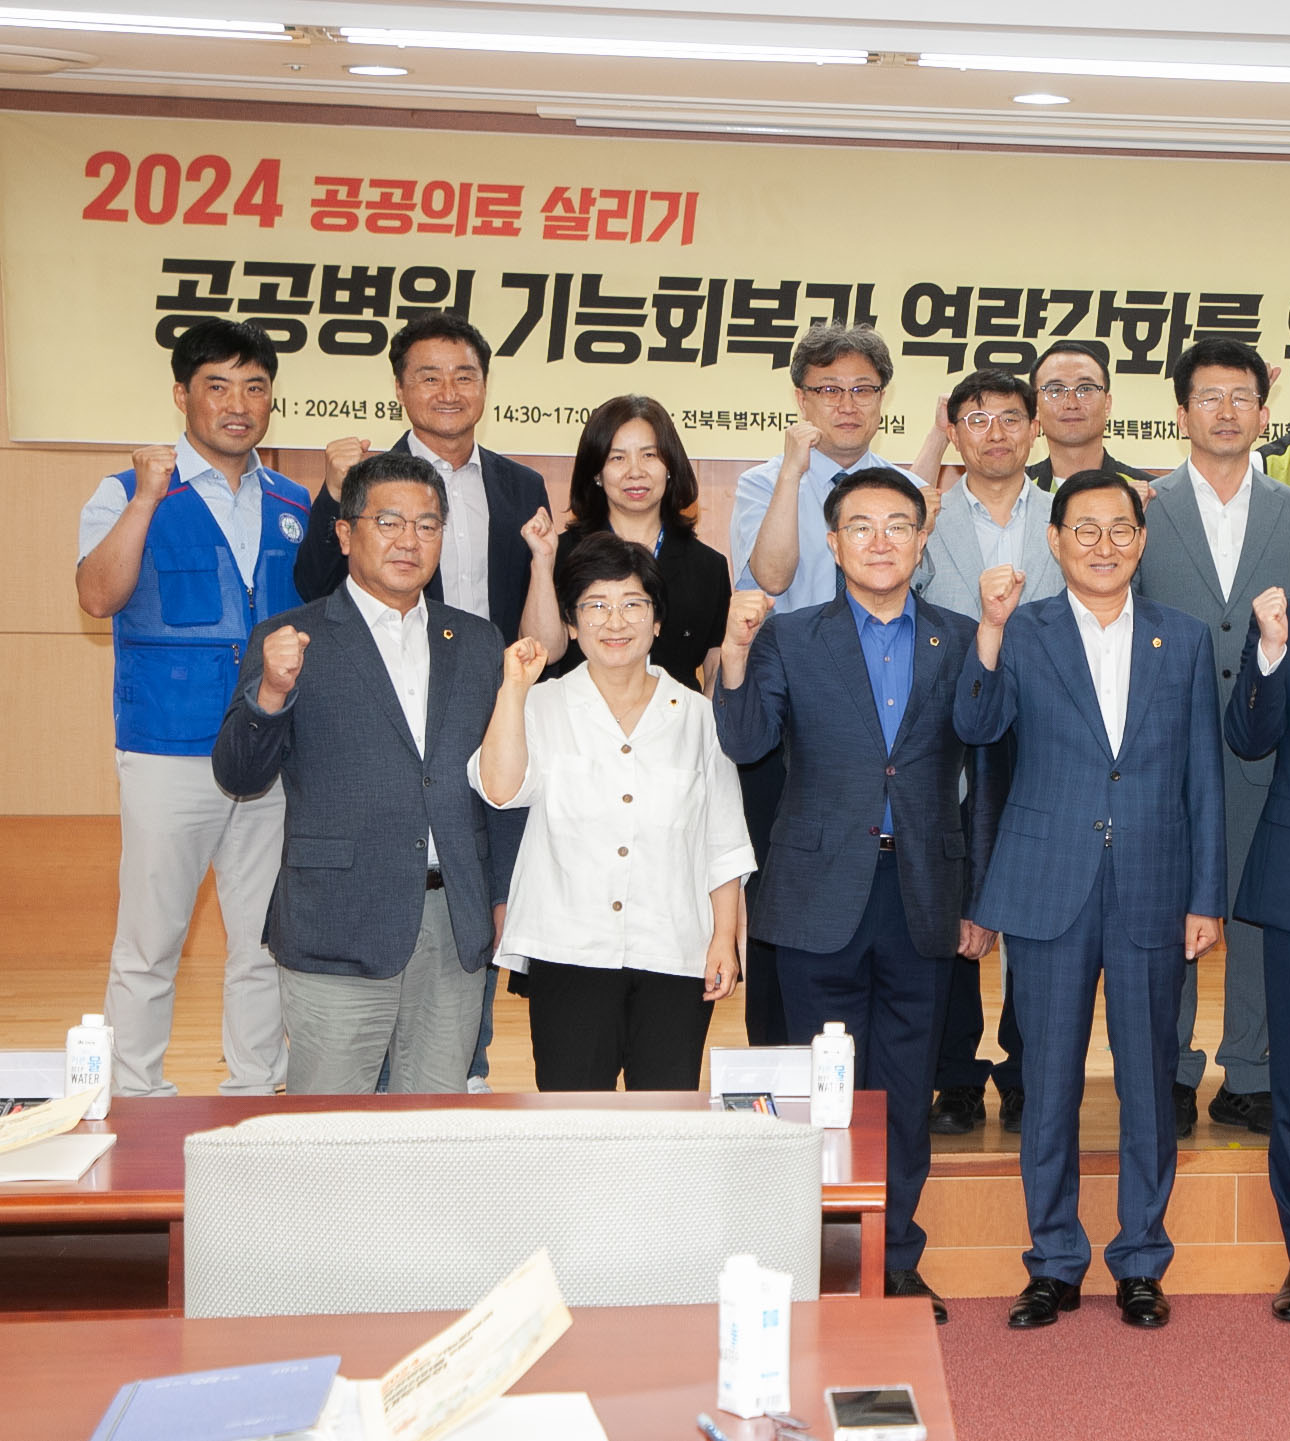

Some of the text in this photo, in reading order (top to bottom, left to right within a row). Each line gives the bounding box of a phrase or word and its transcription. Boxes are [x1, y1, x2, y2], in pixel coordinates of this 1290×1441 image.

[82, 151, 700, 246] 2024 공공의료 살리기
[901, 282, 1264, 379] 역량강화를
[305, 399, 367, 420] 2024년
[374, 400, 403, 421] 8월
[494, 404, 597, 425] 14:30~17:0
[71, 1073, 100, 1085] WATER
